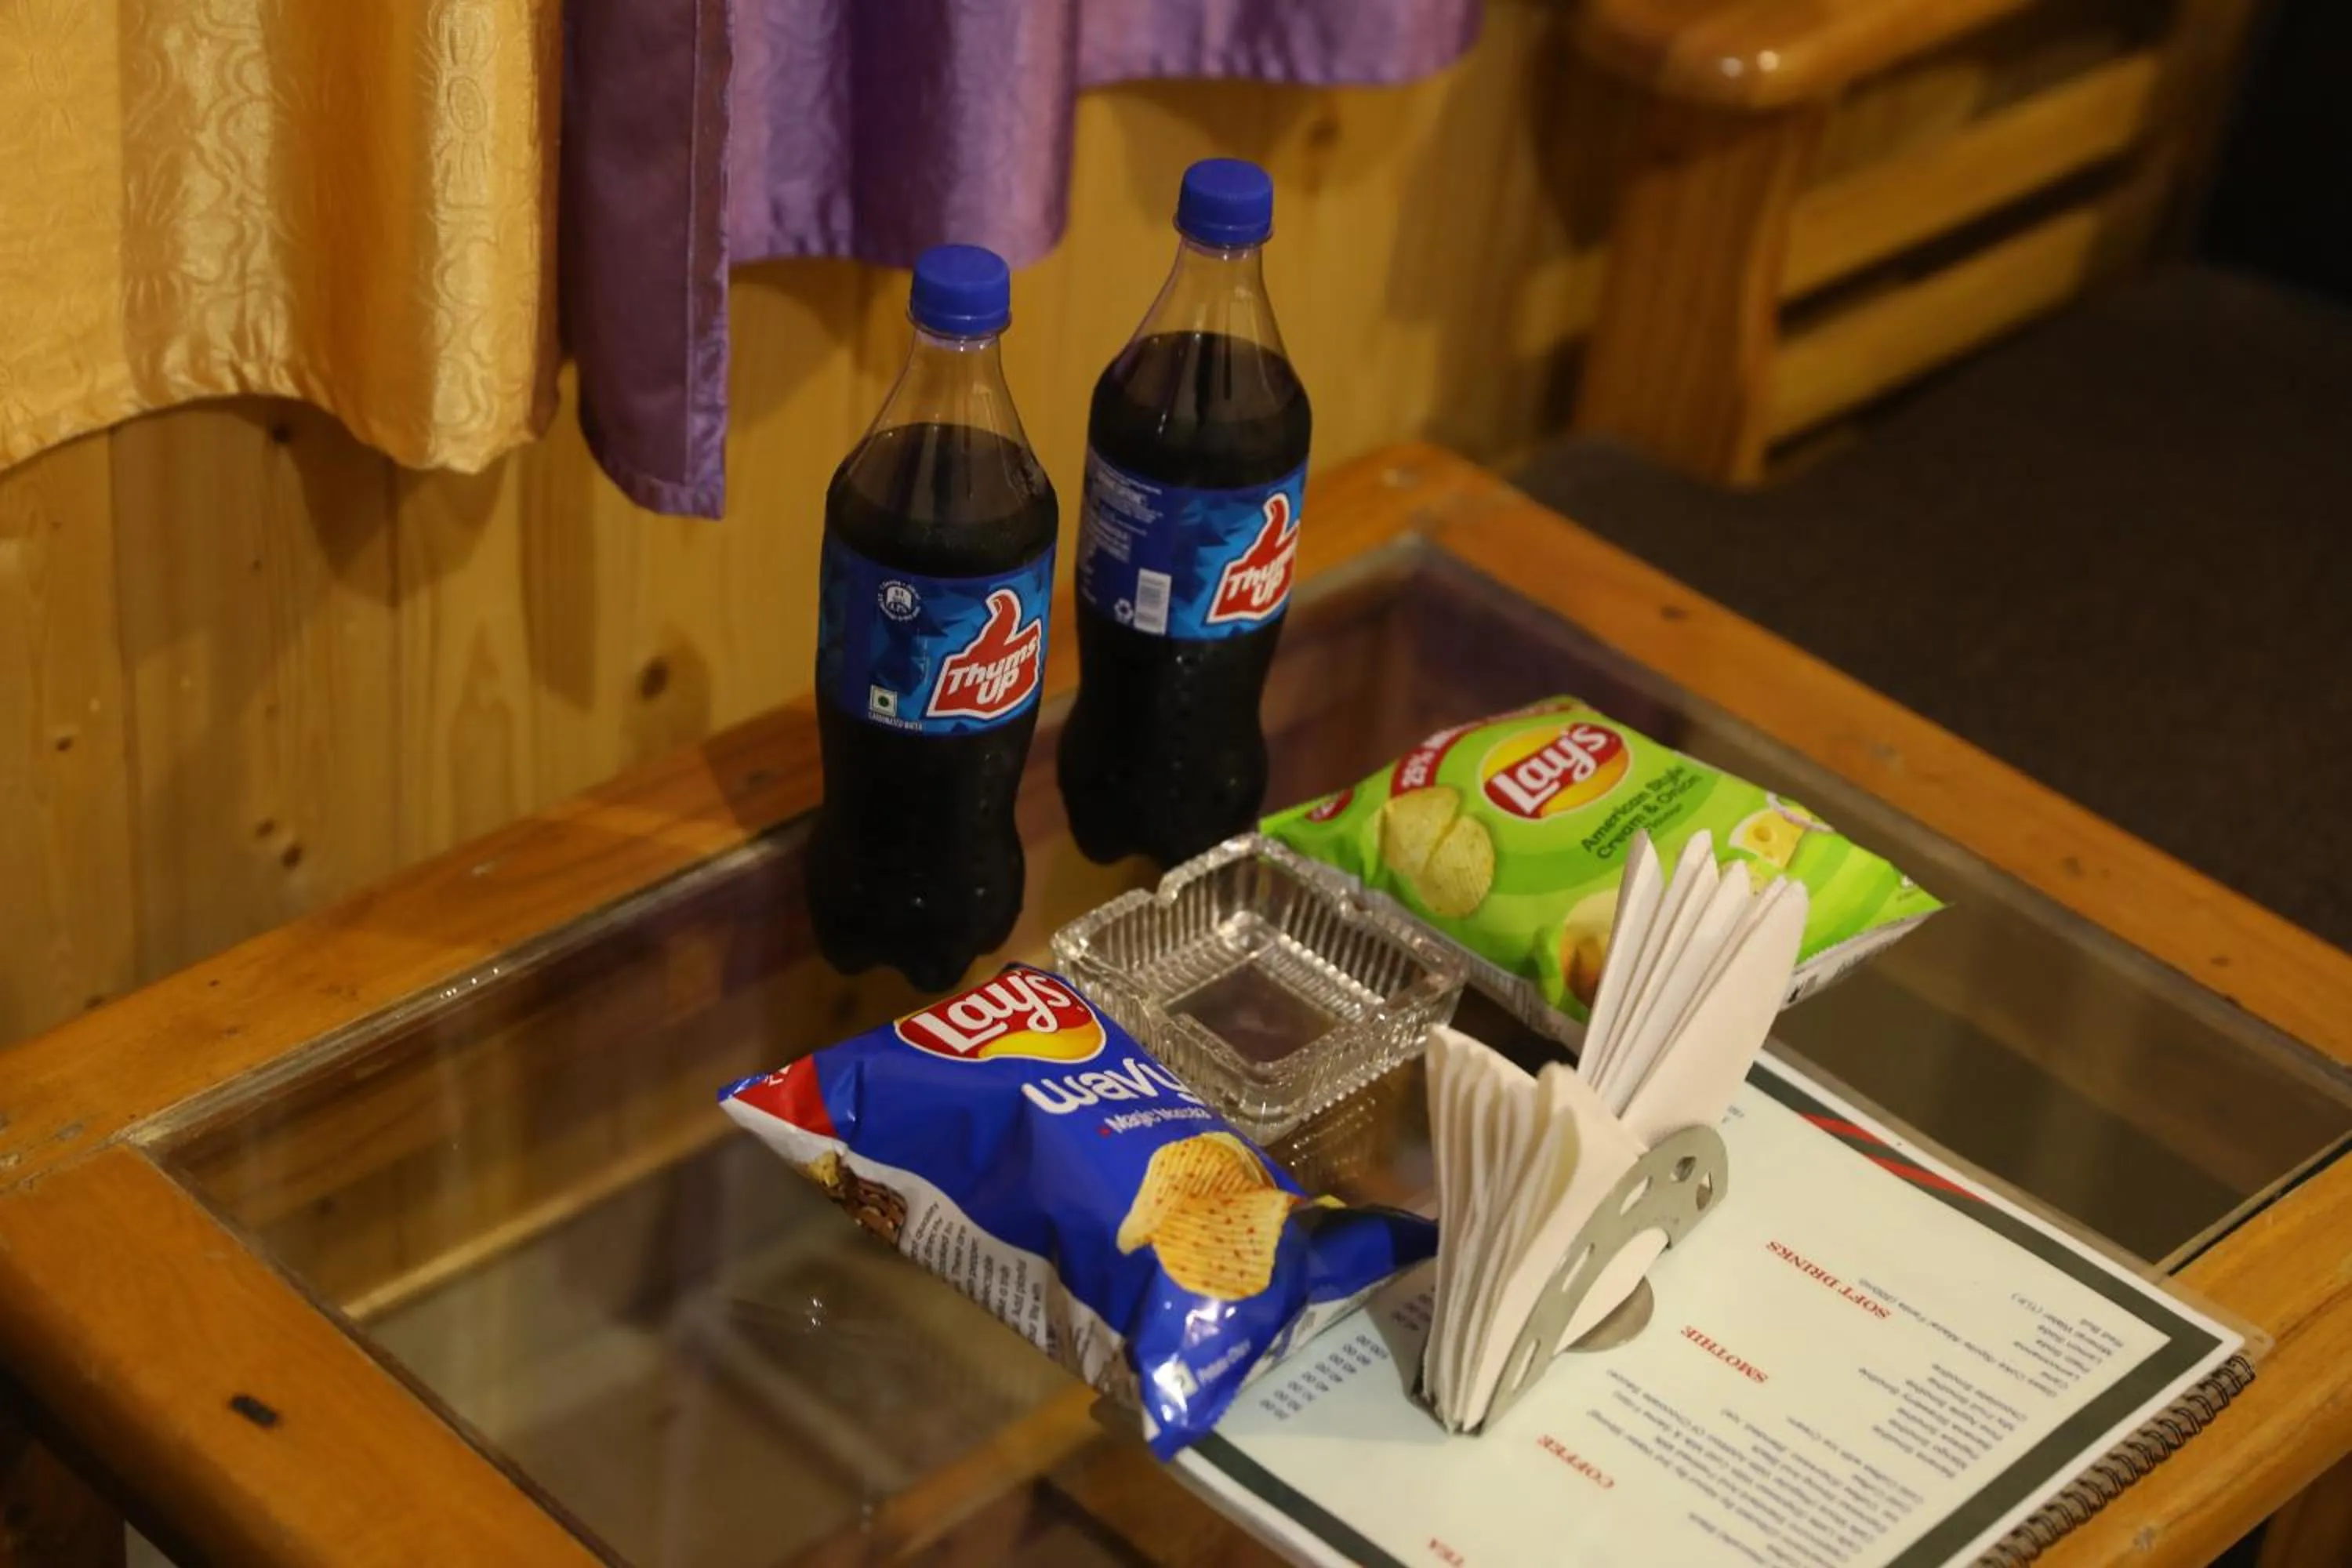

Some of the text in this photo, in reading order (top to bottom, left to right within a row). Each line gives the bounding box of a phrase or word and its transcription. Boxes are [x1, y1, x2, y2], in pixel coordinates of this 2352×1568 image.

[1492, 726, 1607, 814] Lay's
[1581, 790, 1651, 853] American
[1596, 812, 1647, 859] Cream
[1656, 774, 1704, 804] Onion
[911, 971, 1072, 1054] Lay's
[1765, 1240, 1892, 1319] SOFT DRINKS
[1680, 1324, 1769, 1385] SMOTHIE
[1537, 1433, 1616, 1490] COFFEE
